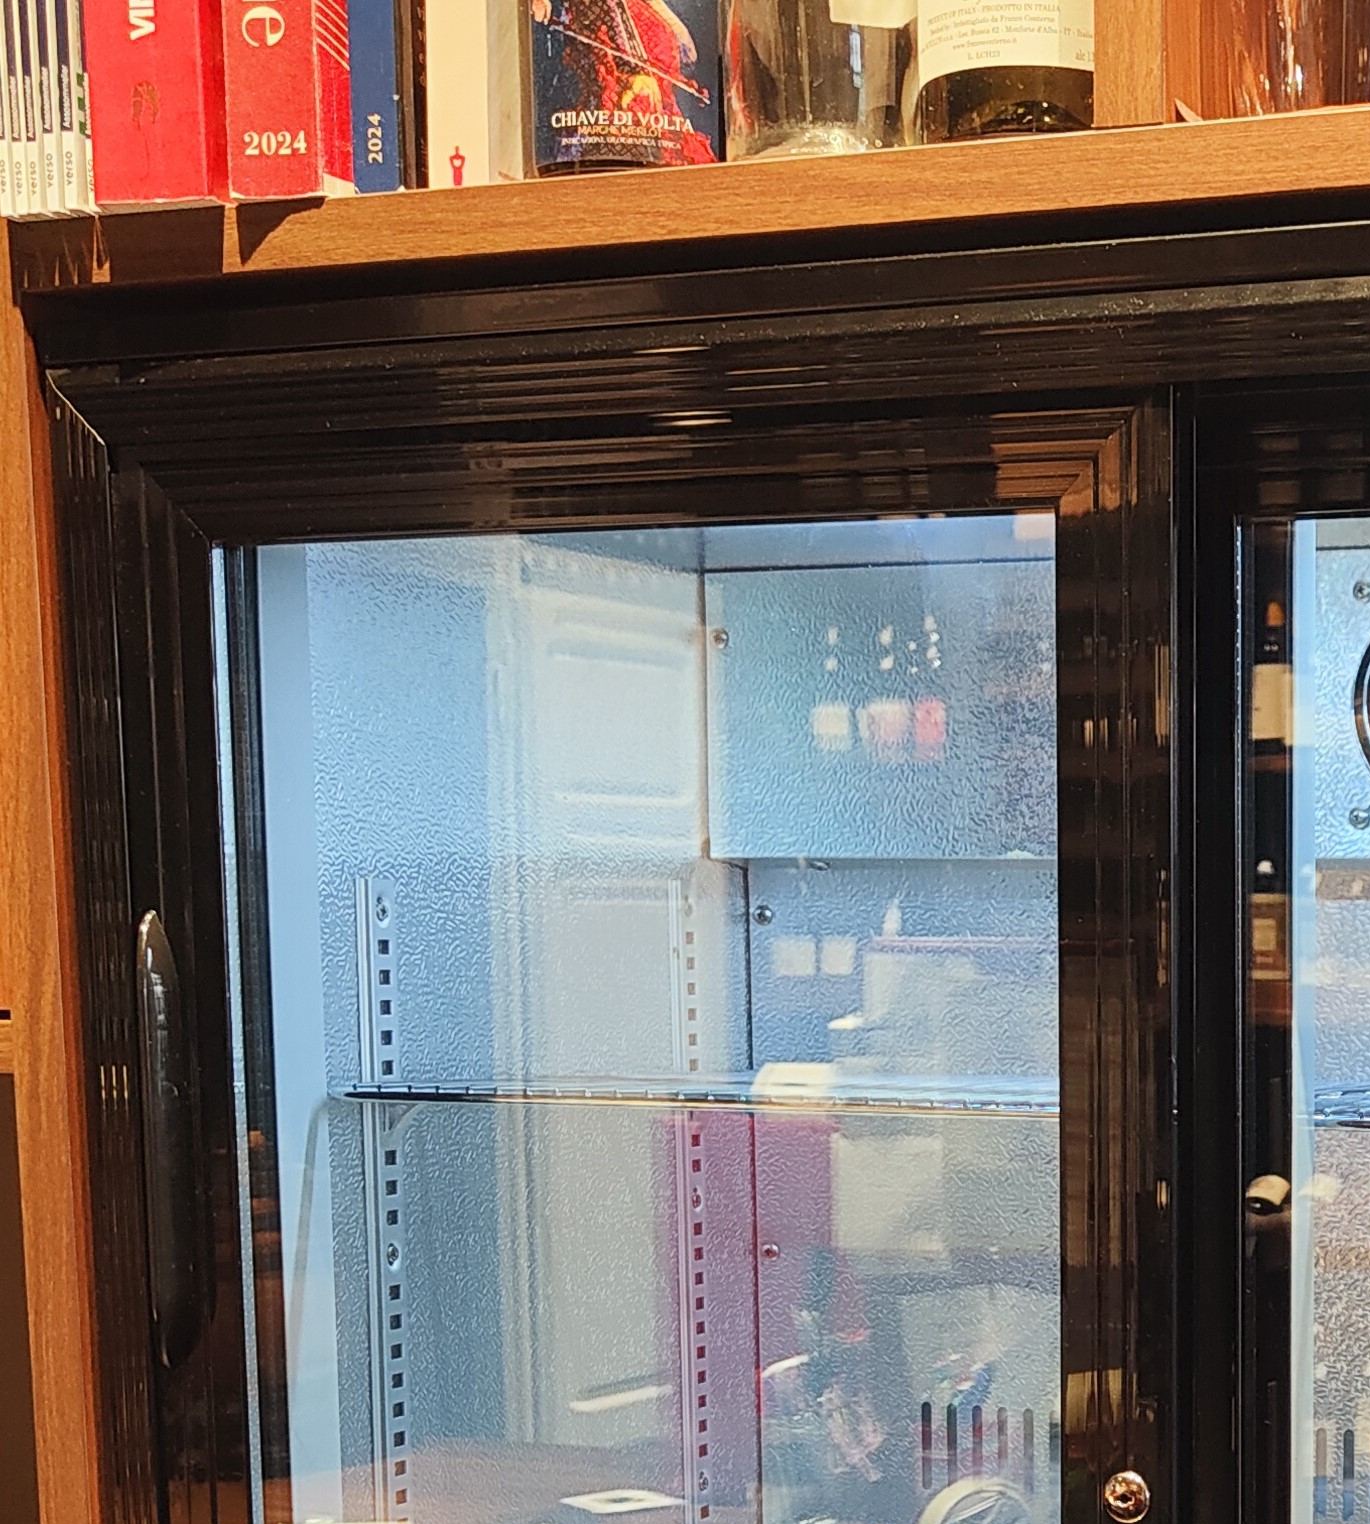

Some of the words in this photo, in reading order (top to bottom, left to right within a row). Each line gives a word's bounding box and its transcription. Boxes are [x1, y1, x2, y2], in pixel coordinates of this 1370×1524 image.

[981, 4, 1022, 13] PRODOTTO
[1024, 3, 1033, 11] IN
[1034, 4, 1061, 13] ITALIA
[999, 14, 1023, 22] Franco
[1024, 14, 1055, 23] Conterno
[1005, 25, 1035, 33] Monforte
[551, 110, 610, 128] CHIAVE
[613, 110, 633, 126] DI
[637, 111, 695, 135] VOLTA
[577, 125, 620, 136] MARCHE
[621, 125, 662, 138] MERLOT
[243, 130, 308, 156] 2024
[367, 113, 384, 165] 2024
[14, 161, 23, 197] verso
[29, 161, 38, 197] verso
[46, 153, 54, 189] verso
[65, 151, 74, 187] verso
